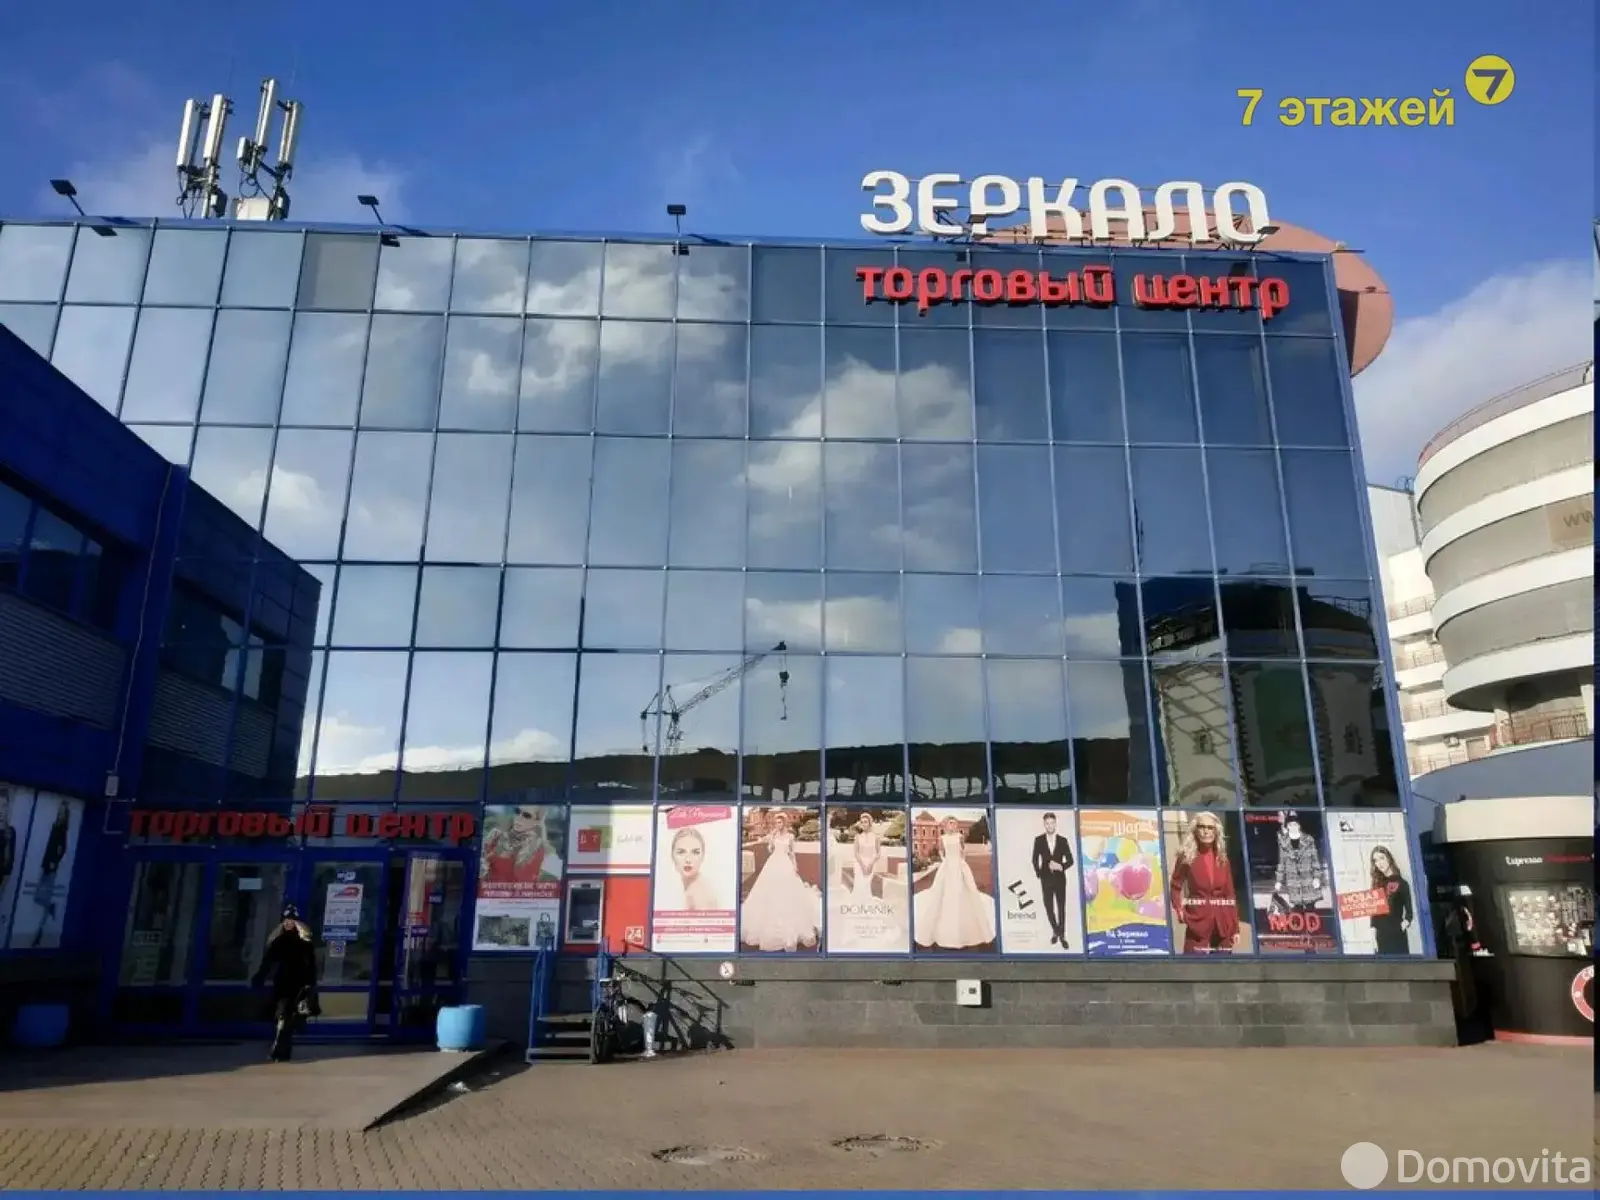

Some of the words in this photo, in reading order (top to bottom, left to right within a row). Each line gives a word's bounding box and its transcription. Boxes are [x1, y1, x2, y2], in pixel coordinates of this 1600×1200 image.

[859, 169, 1271, 243] ЗЕРКАЛО
[855, 264, 1117, 315] торговый
[1132, 272, 1291, 321] центр
[626, 927, 643, 943] 24
